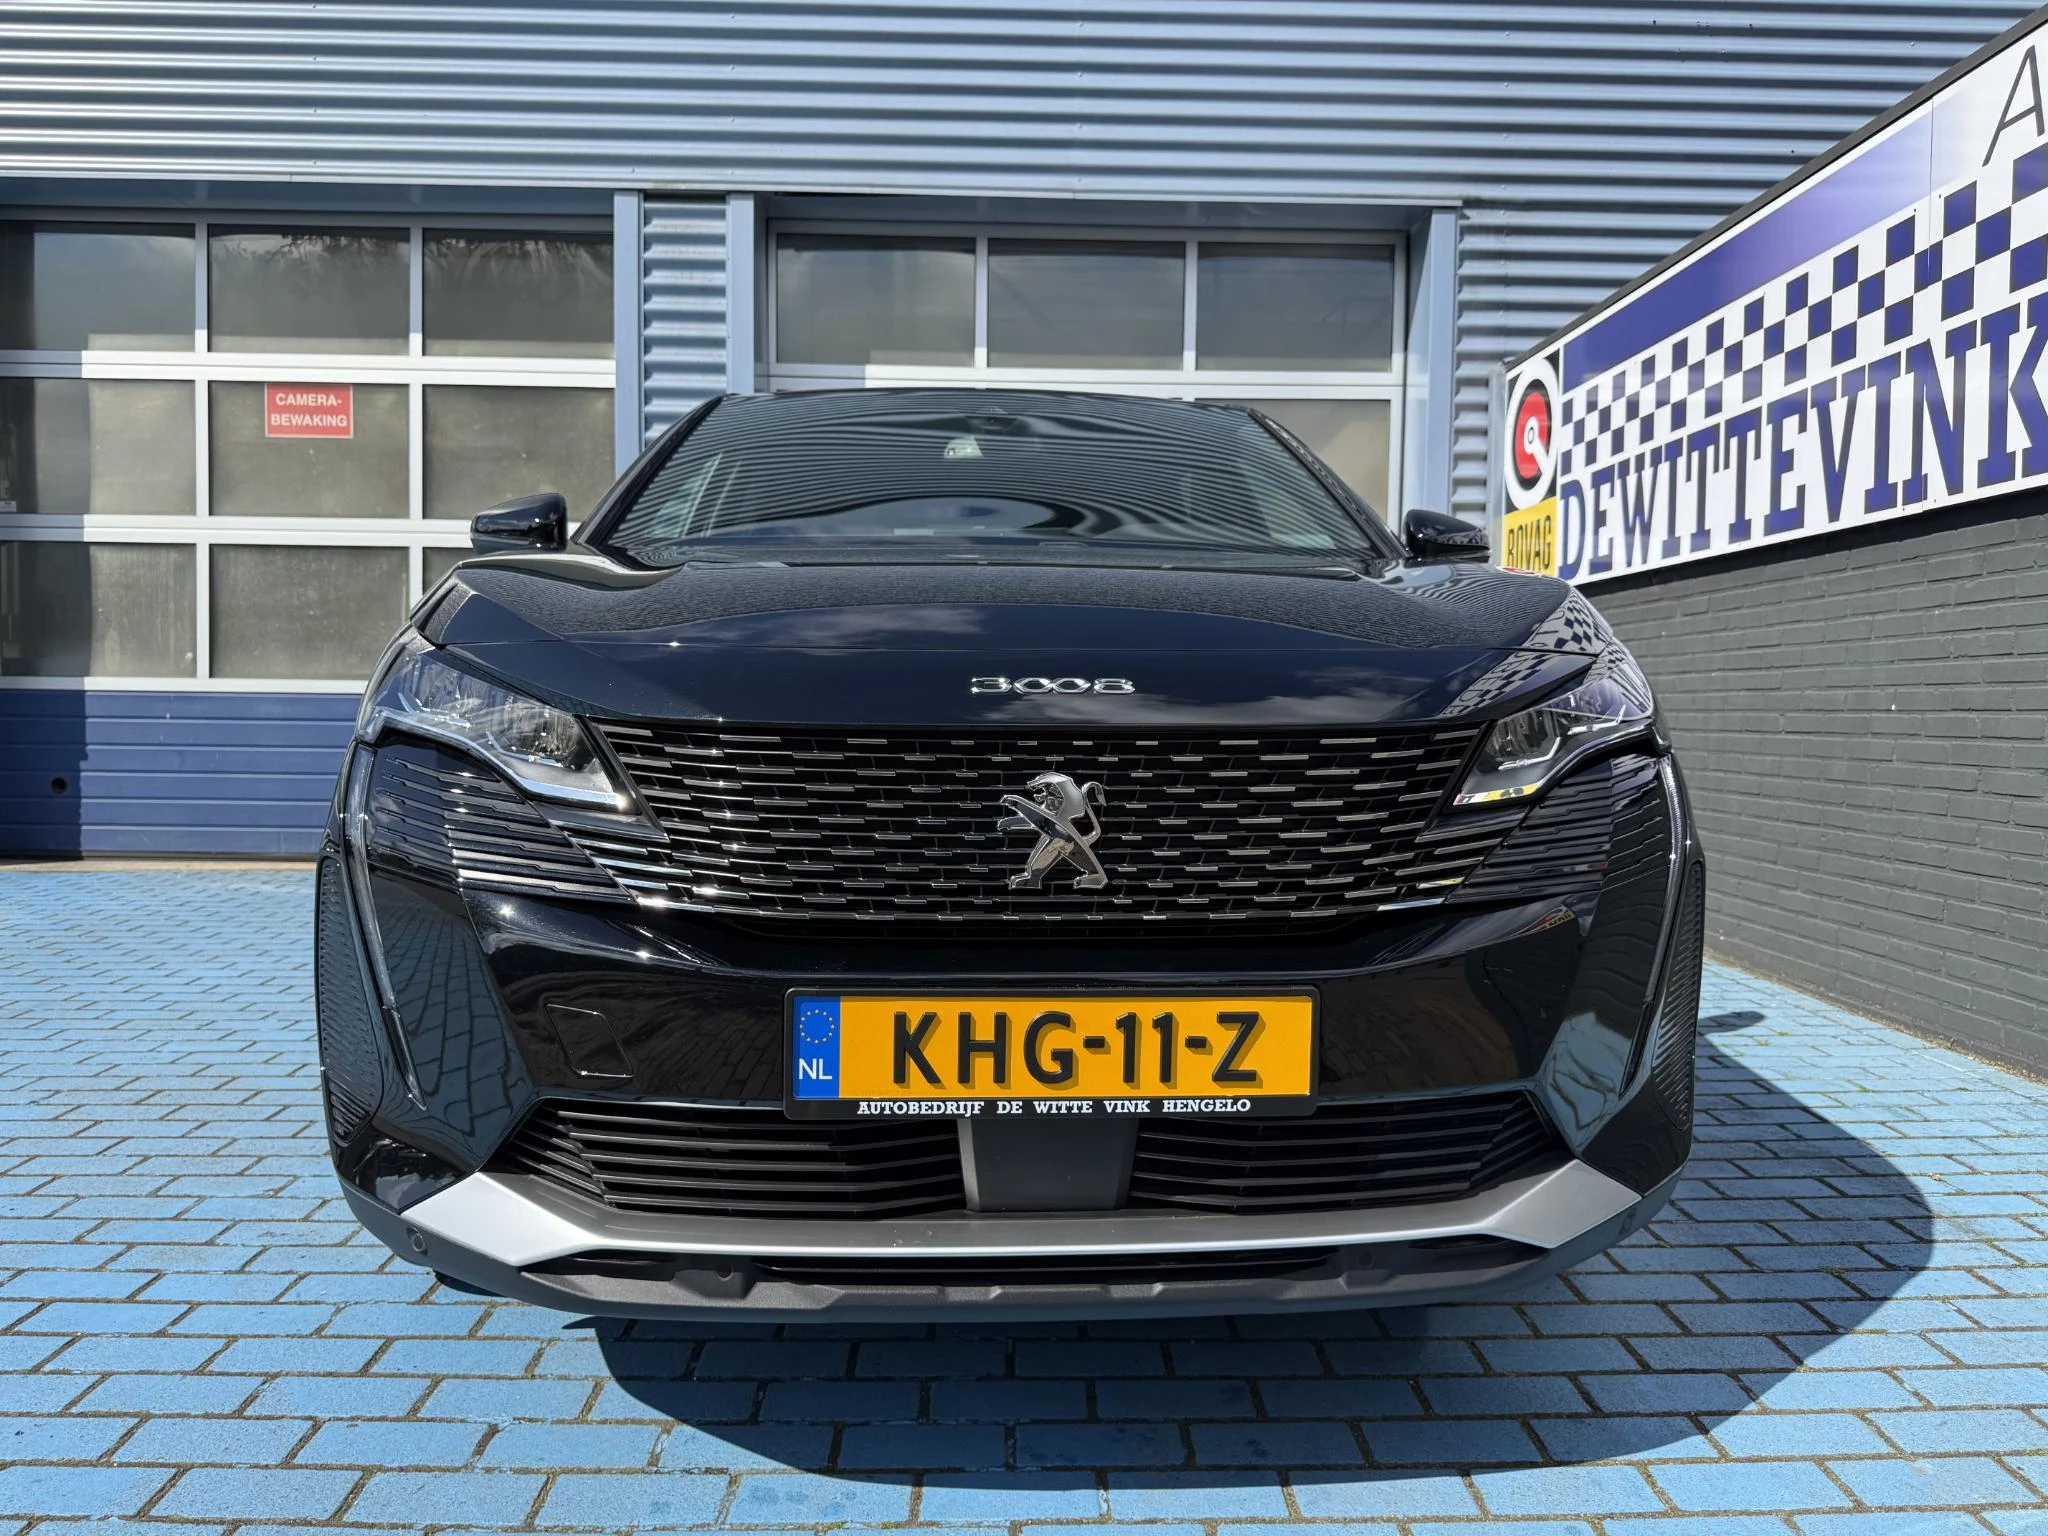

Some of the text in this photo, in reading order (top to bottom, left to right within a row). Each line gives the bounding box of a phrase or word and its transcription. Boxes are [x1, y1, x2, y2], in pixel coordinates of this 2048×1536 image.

[275, 392, 343, 407] CAMERA-
[271, 412, 348, 428] BEWAKING
[971, 677, 1136, 695] 3008
[893, 1011, 1260, 1084] KHG-11-Z
[798, 1058, 833, 1080] NL
[857, 1098, 1252, 1118] AUTOBEDRIJF DE WITTE VINK HENGELO
